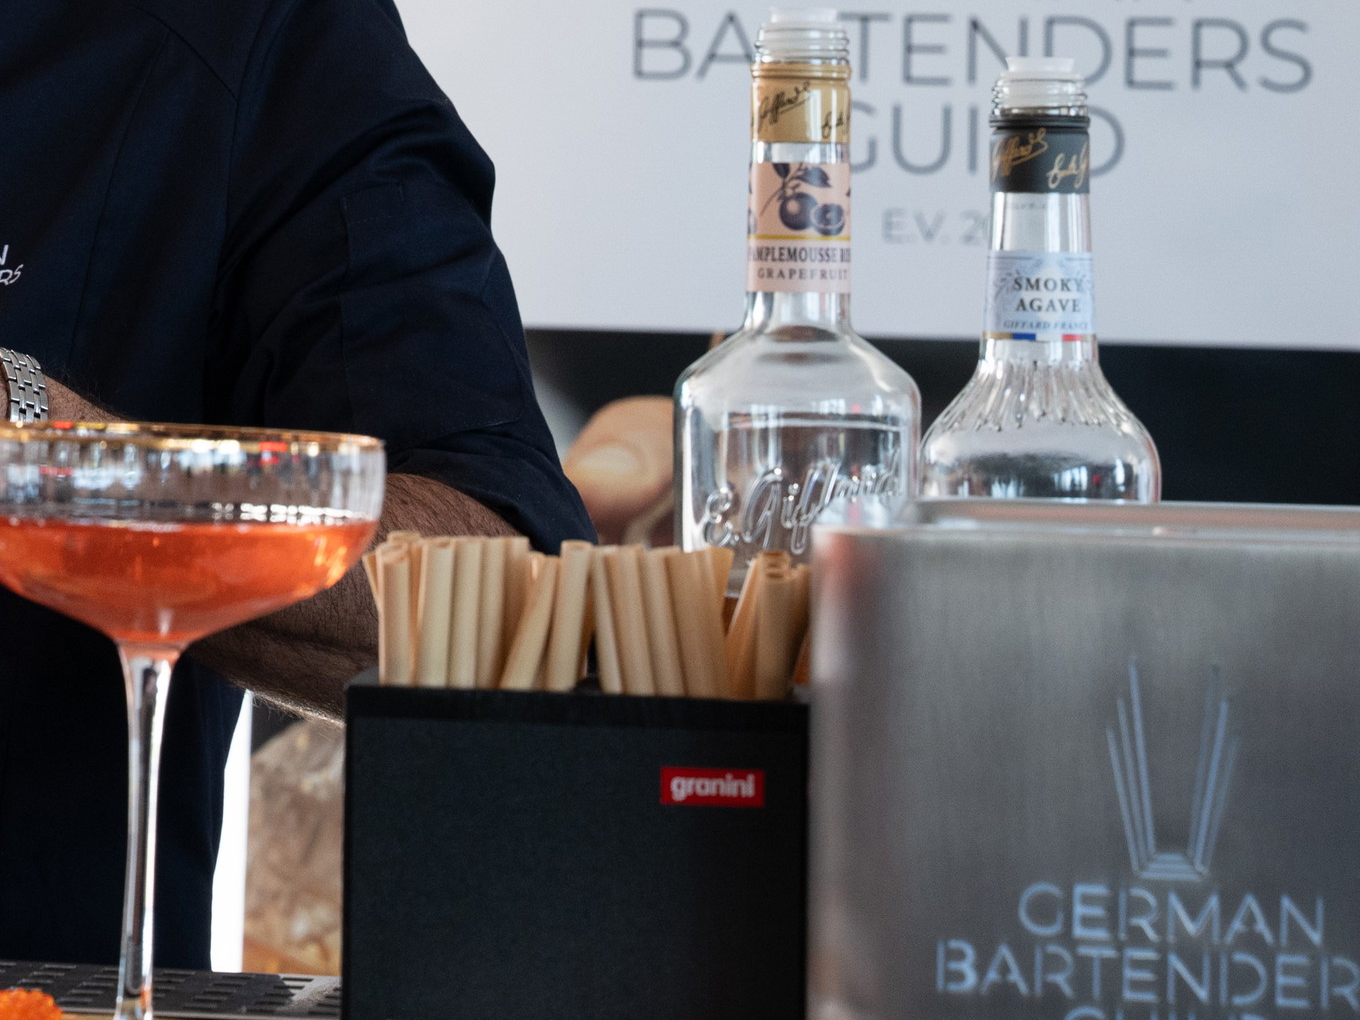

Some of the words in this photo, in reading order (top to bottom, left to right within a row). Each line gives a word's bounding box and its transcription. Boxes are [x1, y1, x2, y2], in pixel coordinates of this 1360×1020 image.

[631, 7, 1314, 95] BATENDERS
[756, 267, 849, 280] GRAPEFRUIT
[1012, 277, 1083, 293] SMOKY
[1015, 297, 1081, 313] AGAVE
[670, 772, 755, 802] granini
[1017, 882, 1324, 946] GERMAN
[935, 937, 1360, 1011] BARTENDER
